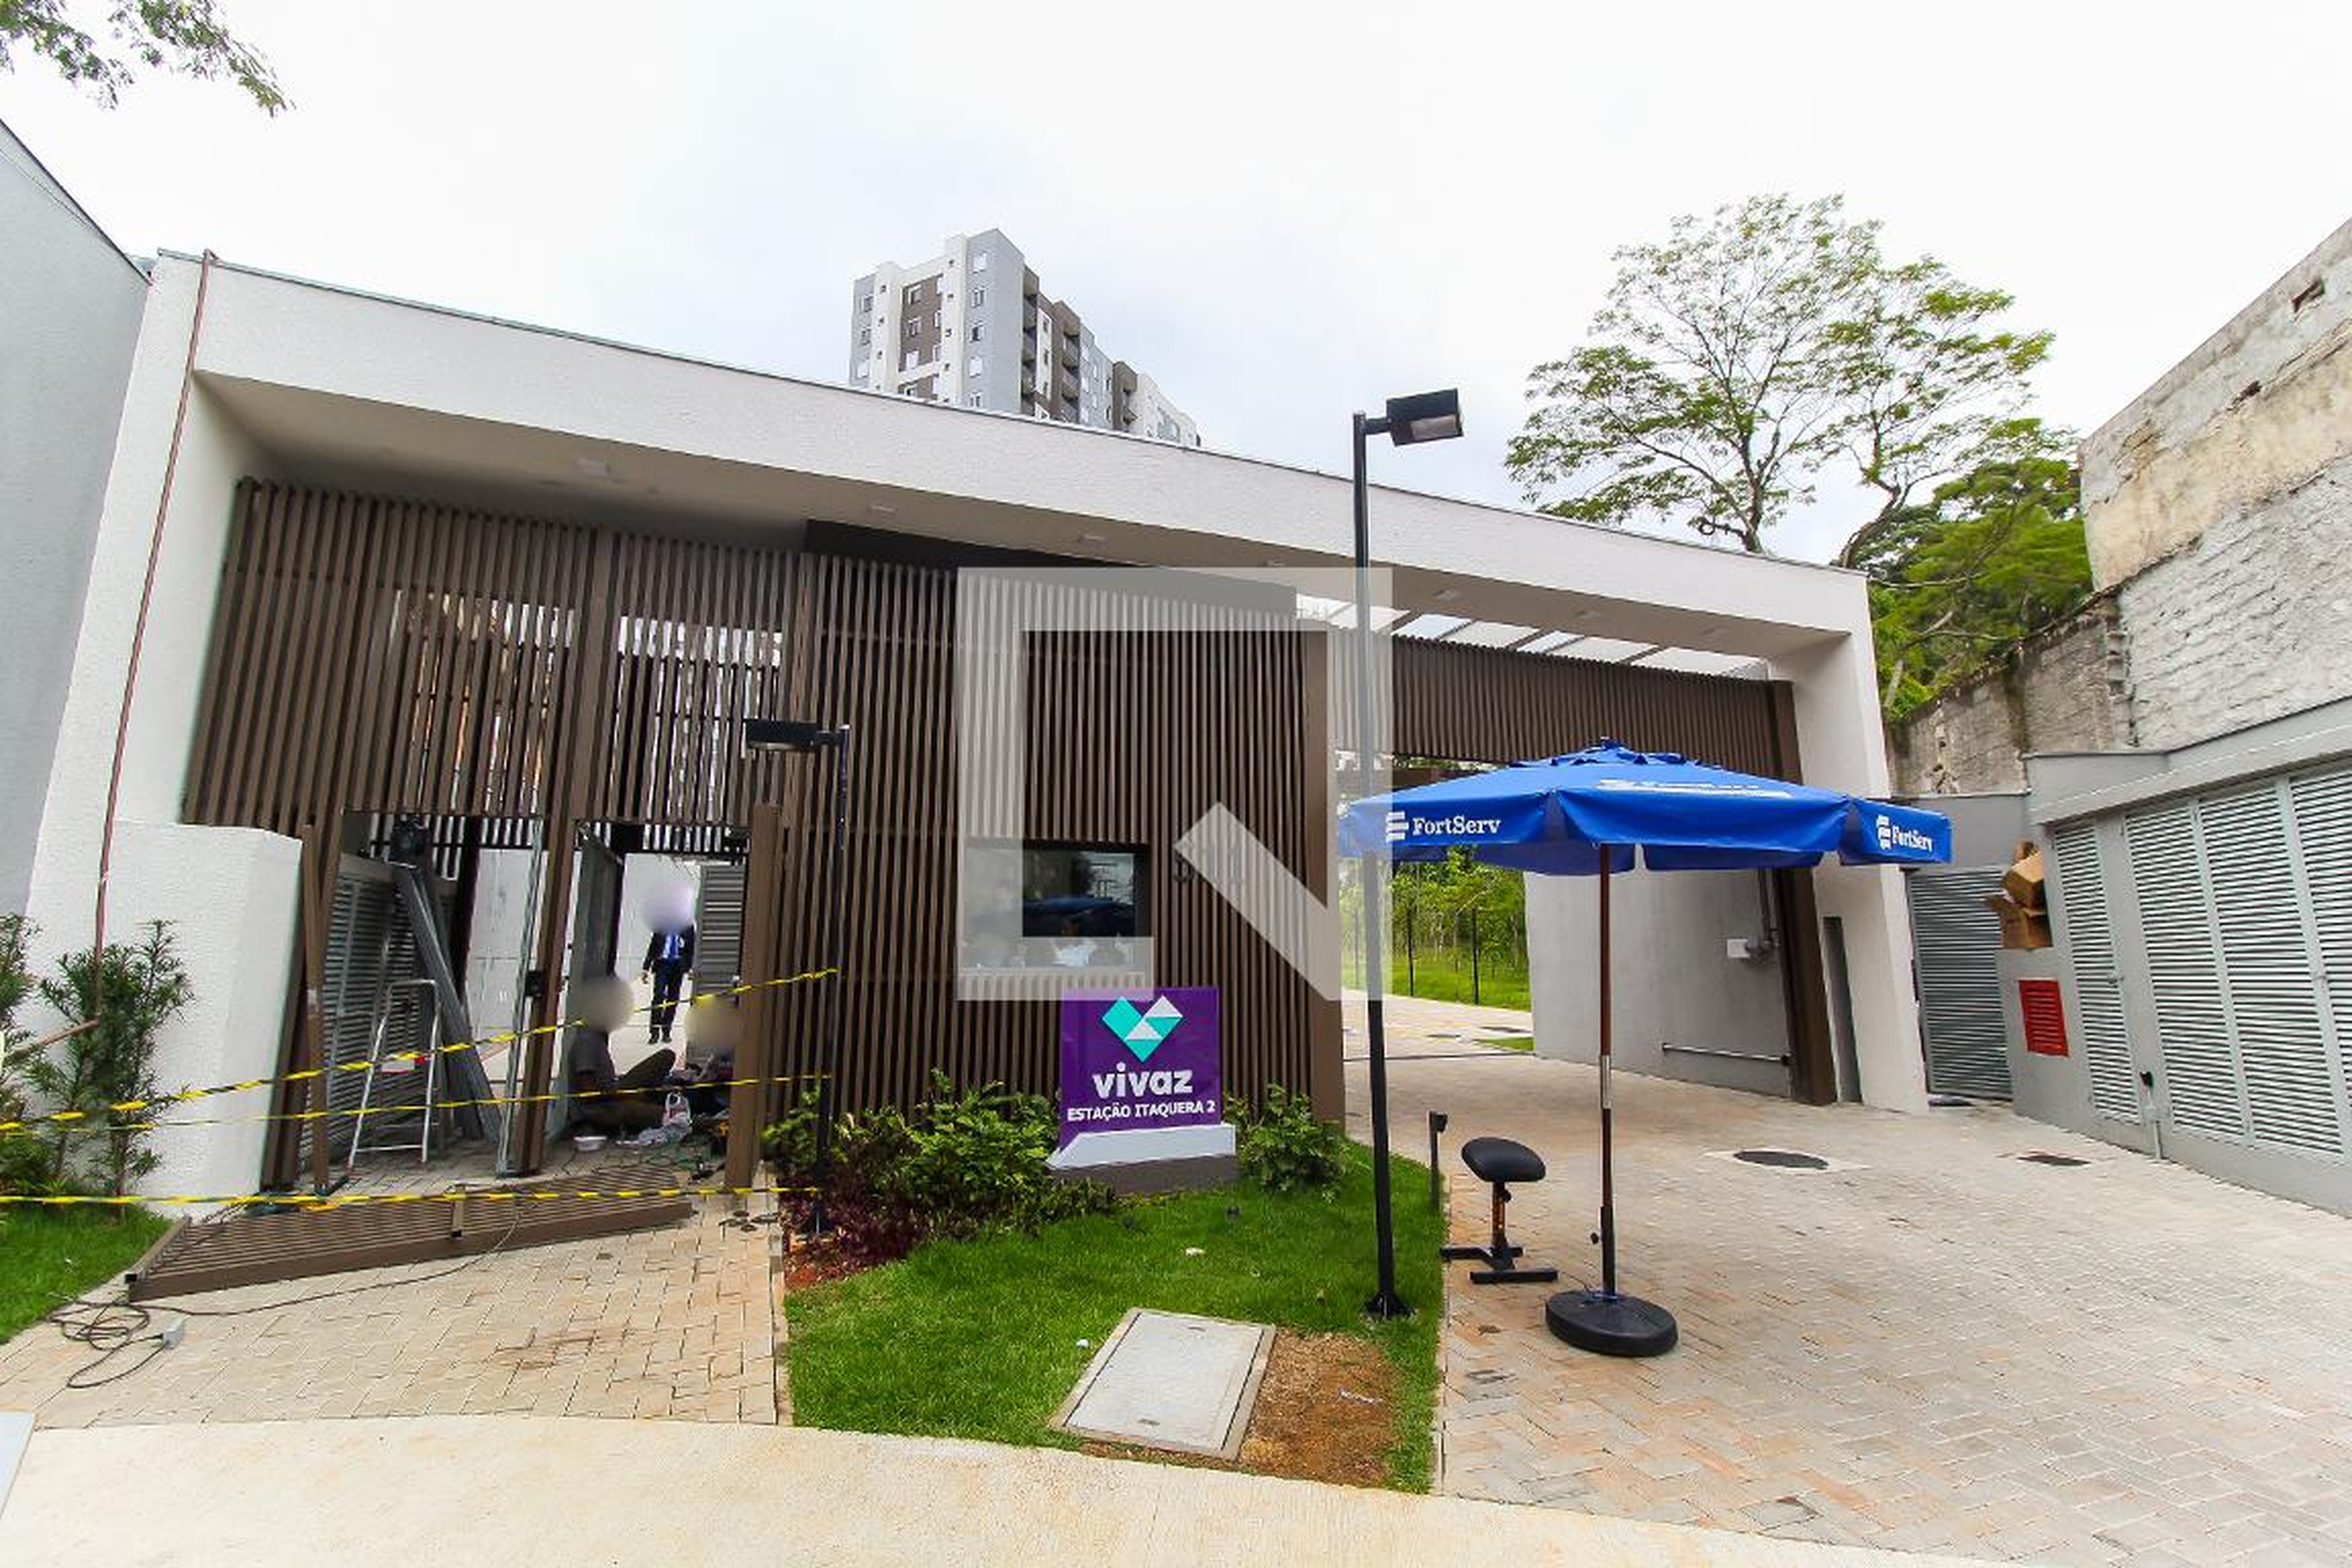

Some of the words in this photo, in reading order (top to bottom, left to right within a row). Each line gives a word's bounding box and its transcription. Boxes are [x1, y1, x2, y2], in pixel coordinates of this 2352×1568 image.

[1412, 816, 1501, 835] FortServ
[1093, 1061, 1193, 1099] vivaz
[1067, 1103, 1131, 1122] ESTAÇÃO
[1135, 1100, 1204, 1118] ITAQUERA
[1205, 1100, 1216, 1113] 2
